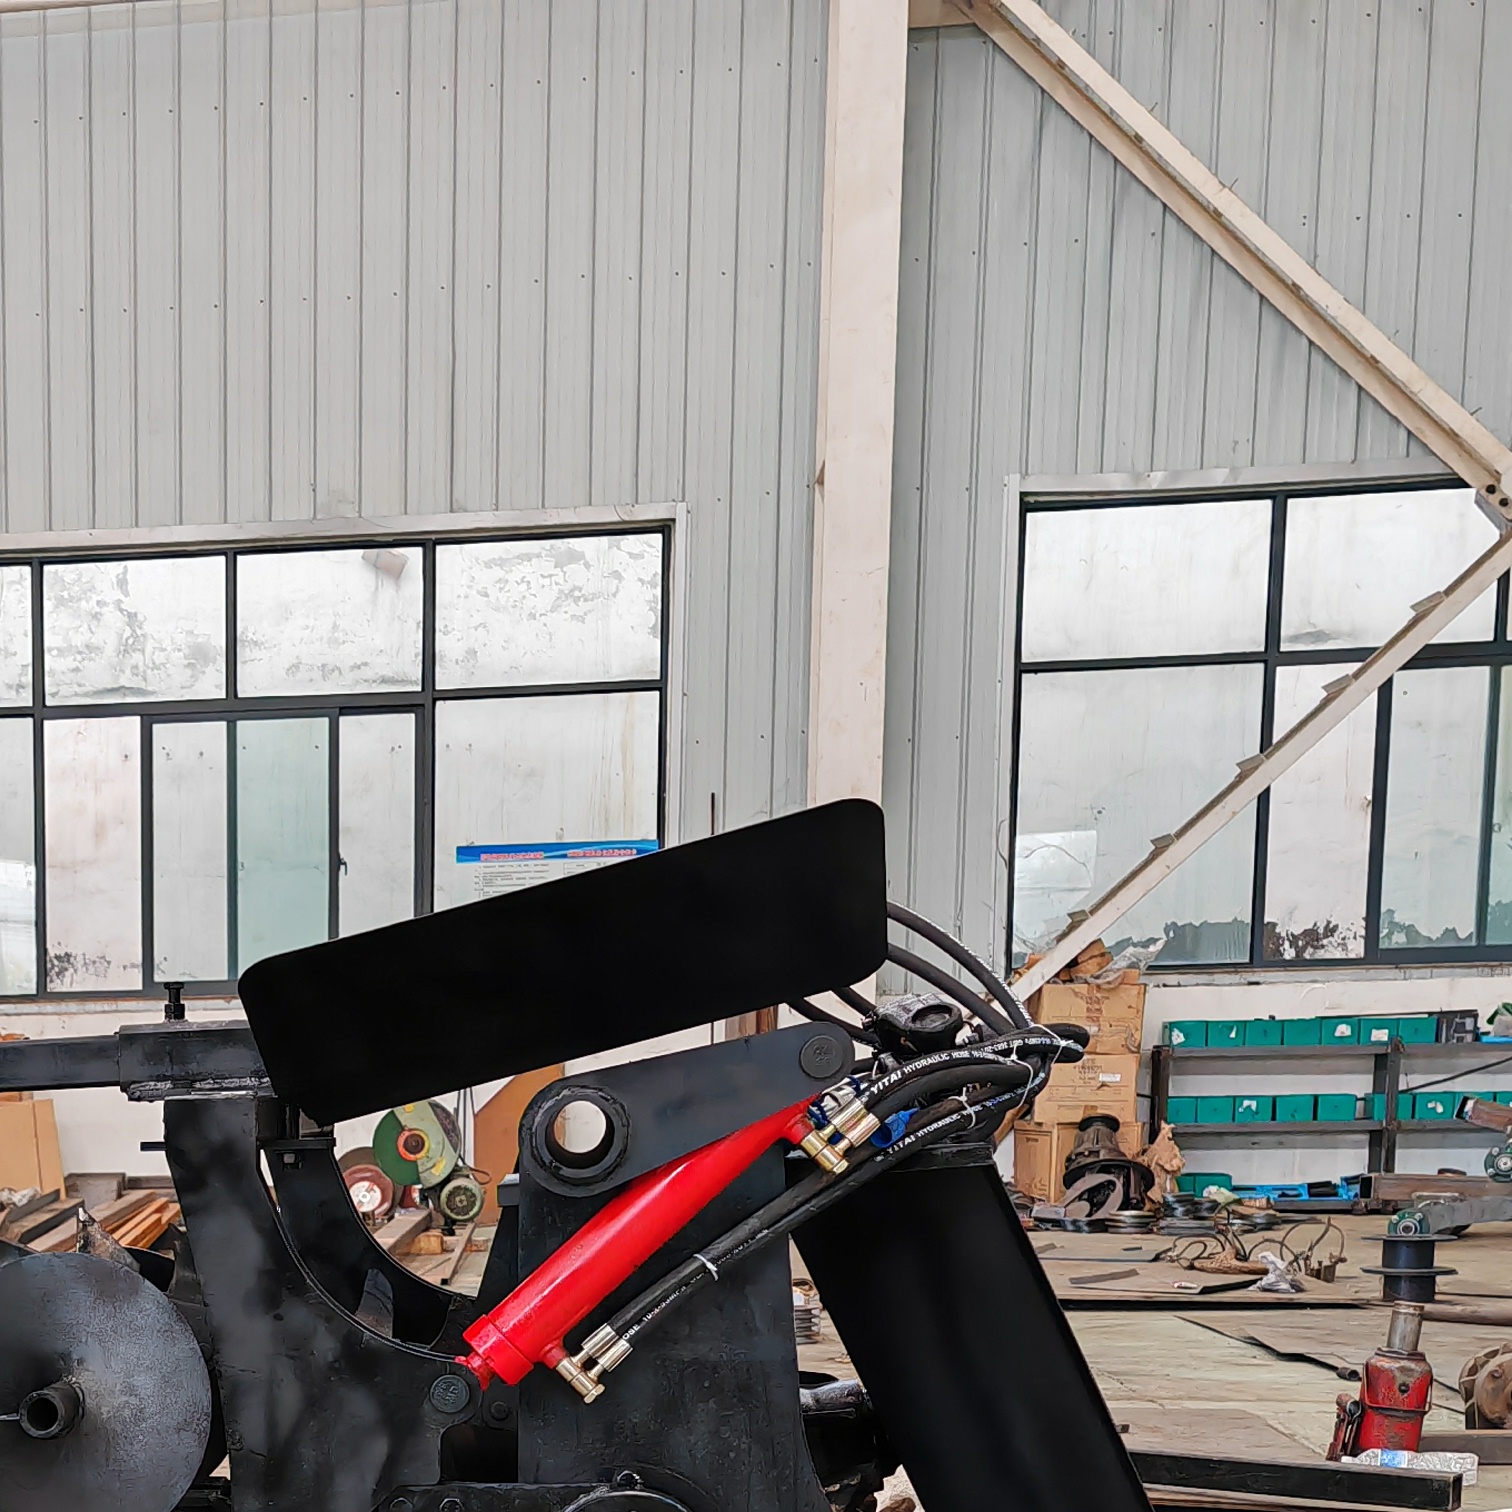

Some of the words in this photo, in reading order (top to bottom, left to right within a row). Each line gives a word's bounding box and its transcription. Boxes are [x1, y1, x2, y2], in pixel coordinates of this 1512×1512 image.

[870, 1070, 902, 1094] YITAI
[903, 1052, 950, 1074] HYDRAULIC
[887, 1134, 916, 1154] YITAI
[916, 1113, 962, 1137] HYDRAULIC
